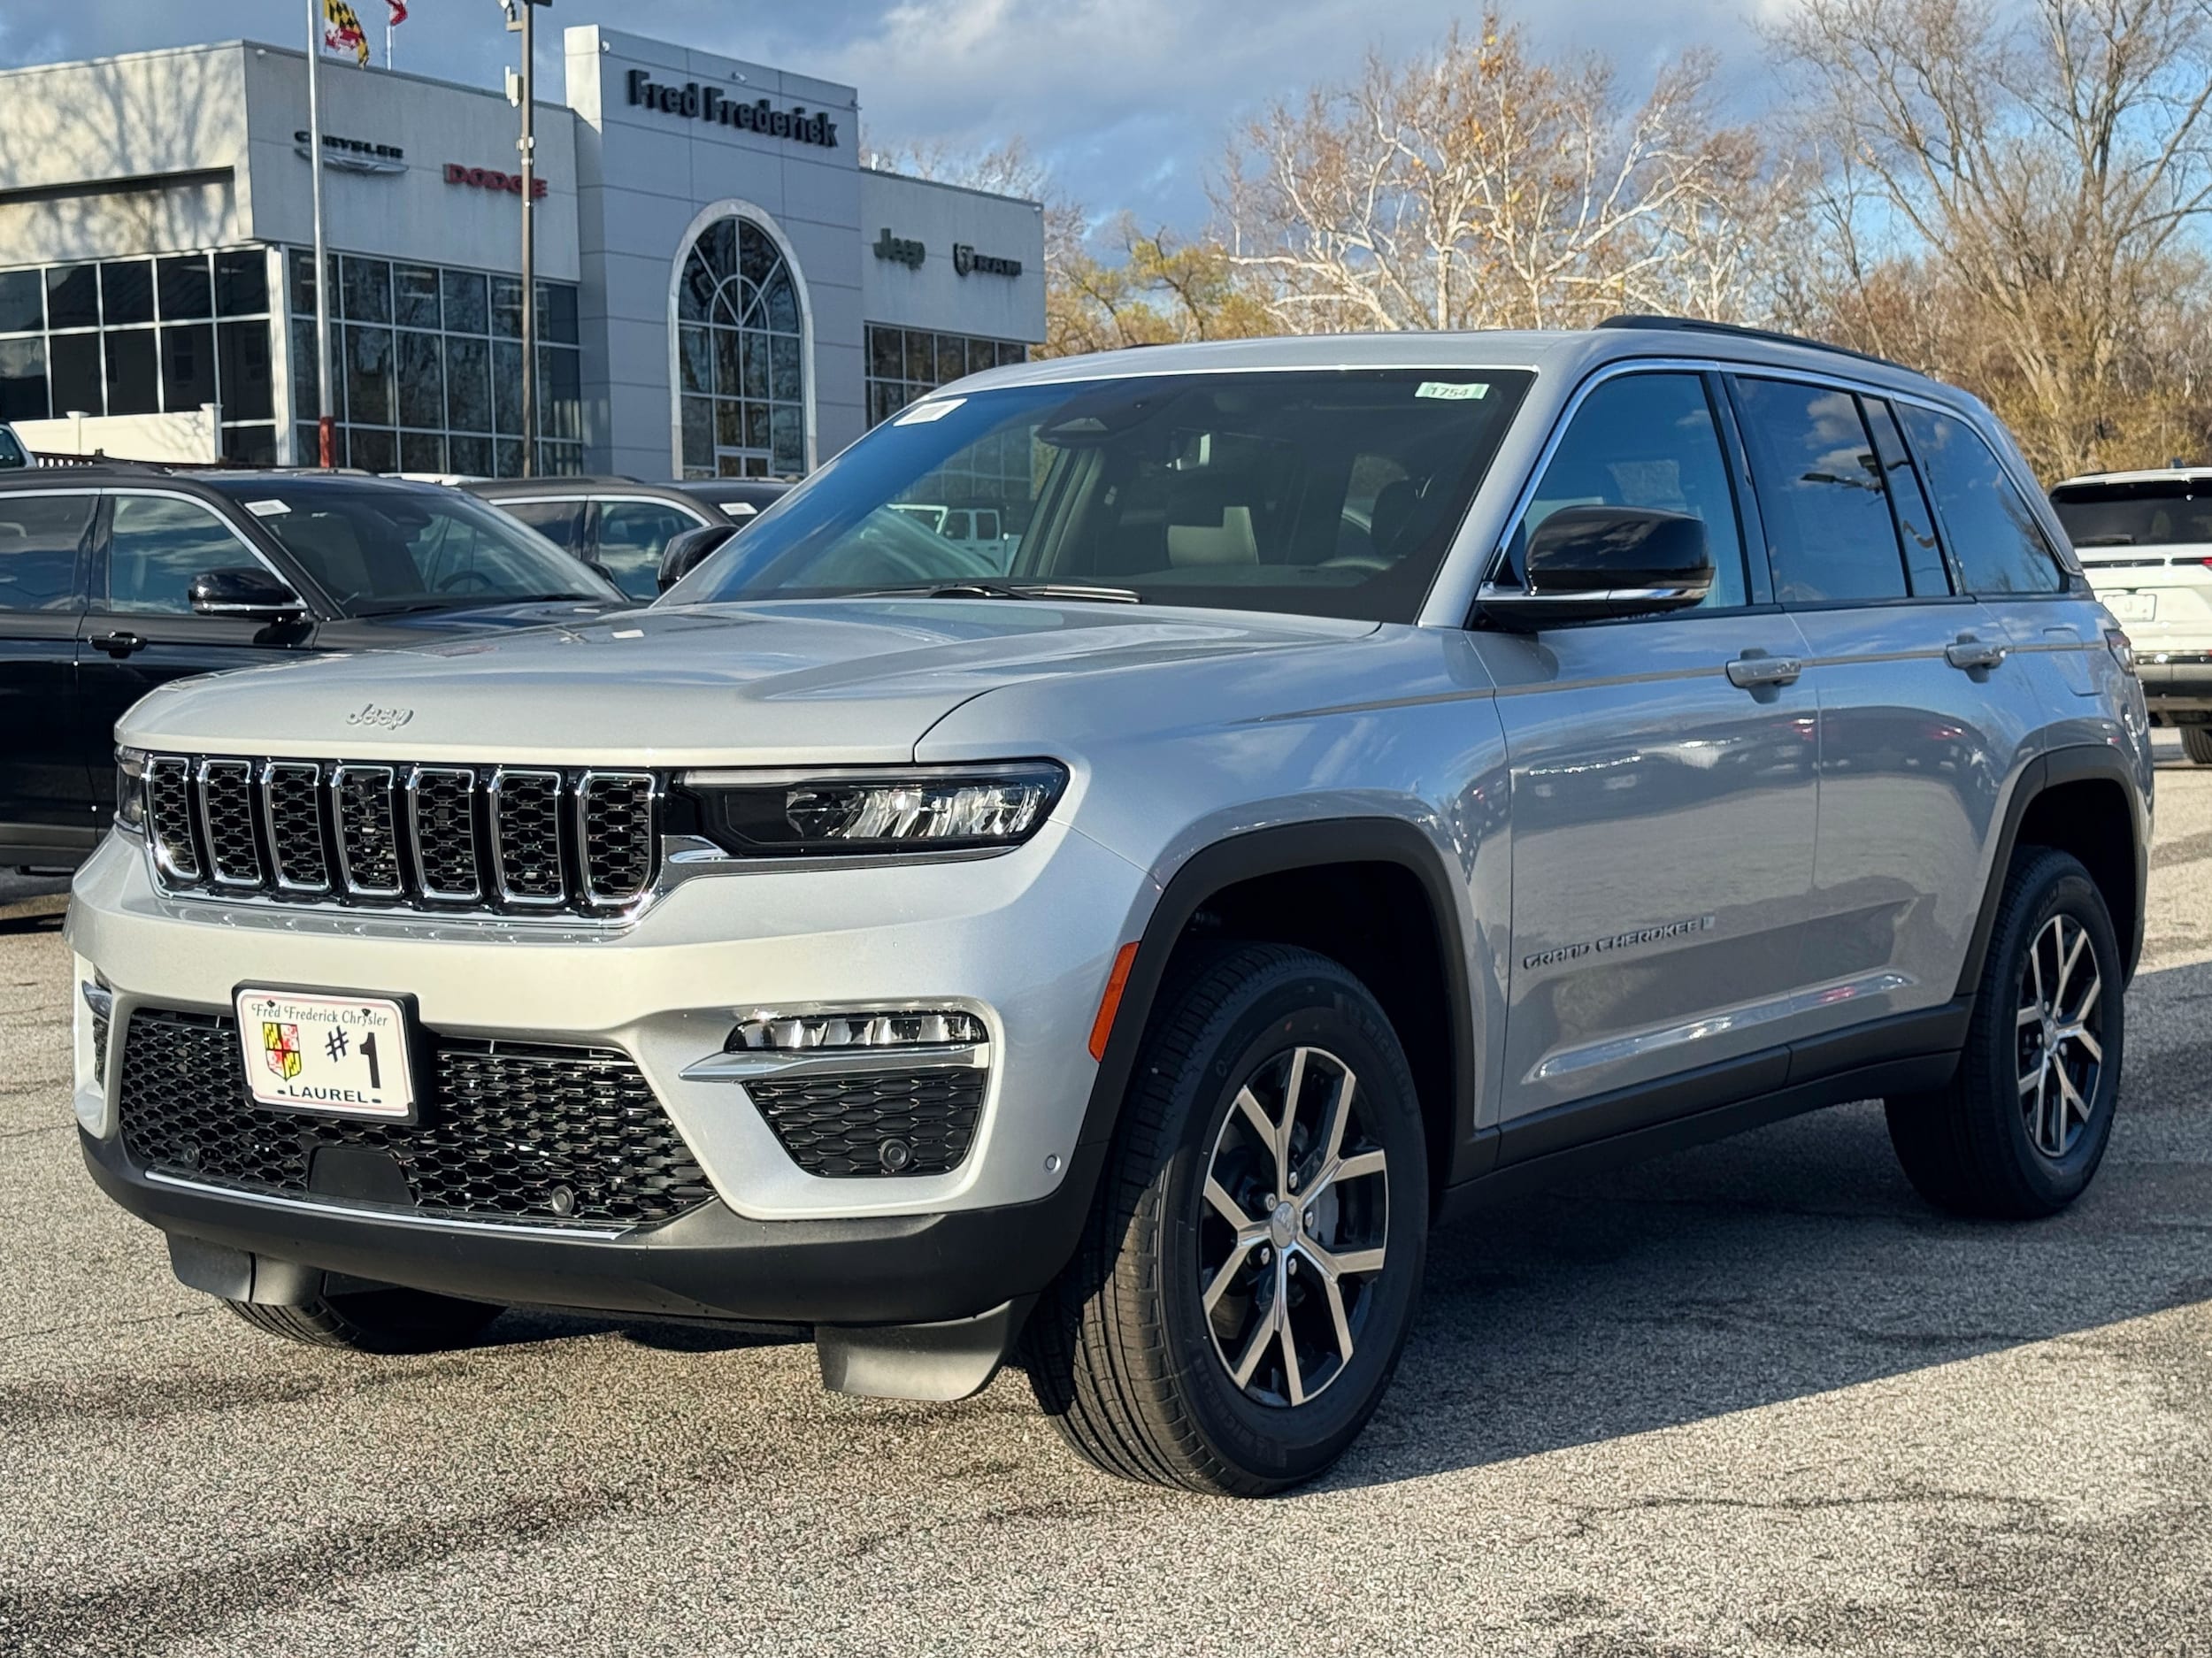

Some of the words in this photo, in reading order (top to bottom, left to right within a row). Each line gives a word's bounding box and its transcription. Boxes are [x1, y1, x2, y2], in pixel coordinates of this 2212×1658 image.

[628, 70, 699, 118] Fred
[703, 86, 838, 148] Frederick
[294, 131, 403, 158] CRYSLER
[872, 227, 926, 271] Jeep
[346, 703, 414, 731] Jeep
[1523, 942, 1592, 970] GRAND
[1596, 919, 1698, 953] CHEROKEE
[251, 1002, 280, 1017] Fred
[284, 1005, 338, 1023] Frederick
[342, 1009, 388, 1027] Chrysler
[325, 1025, 381, 1089] #1
[289, 1085, 369, 1103] LAUREL
